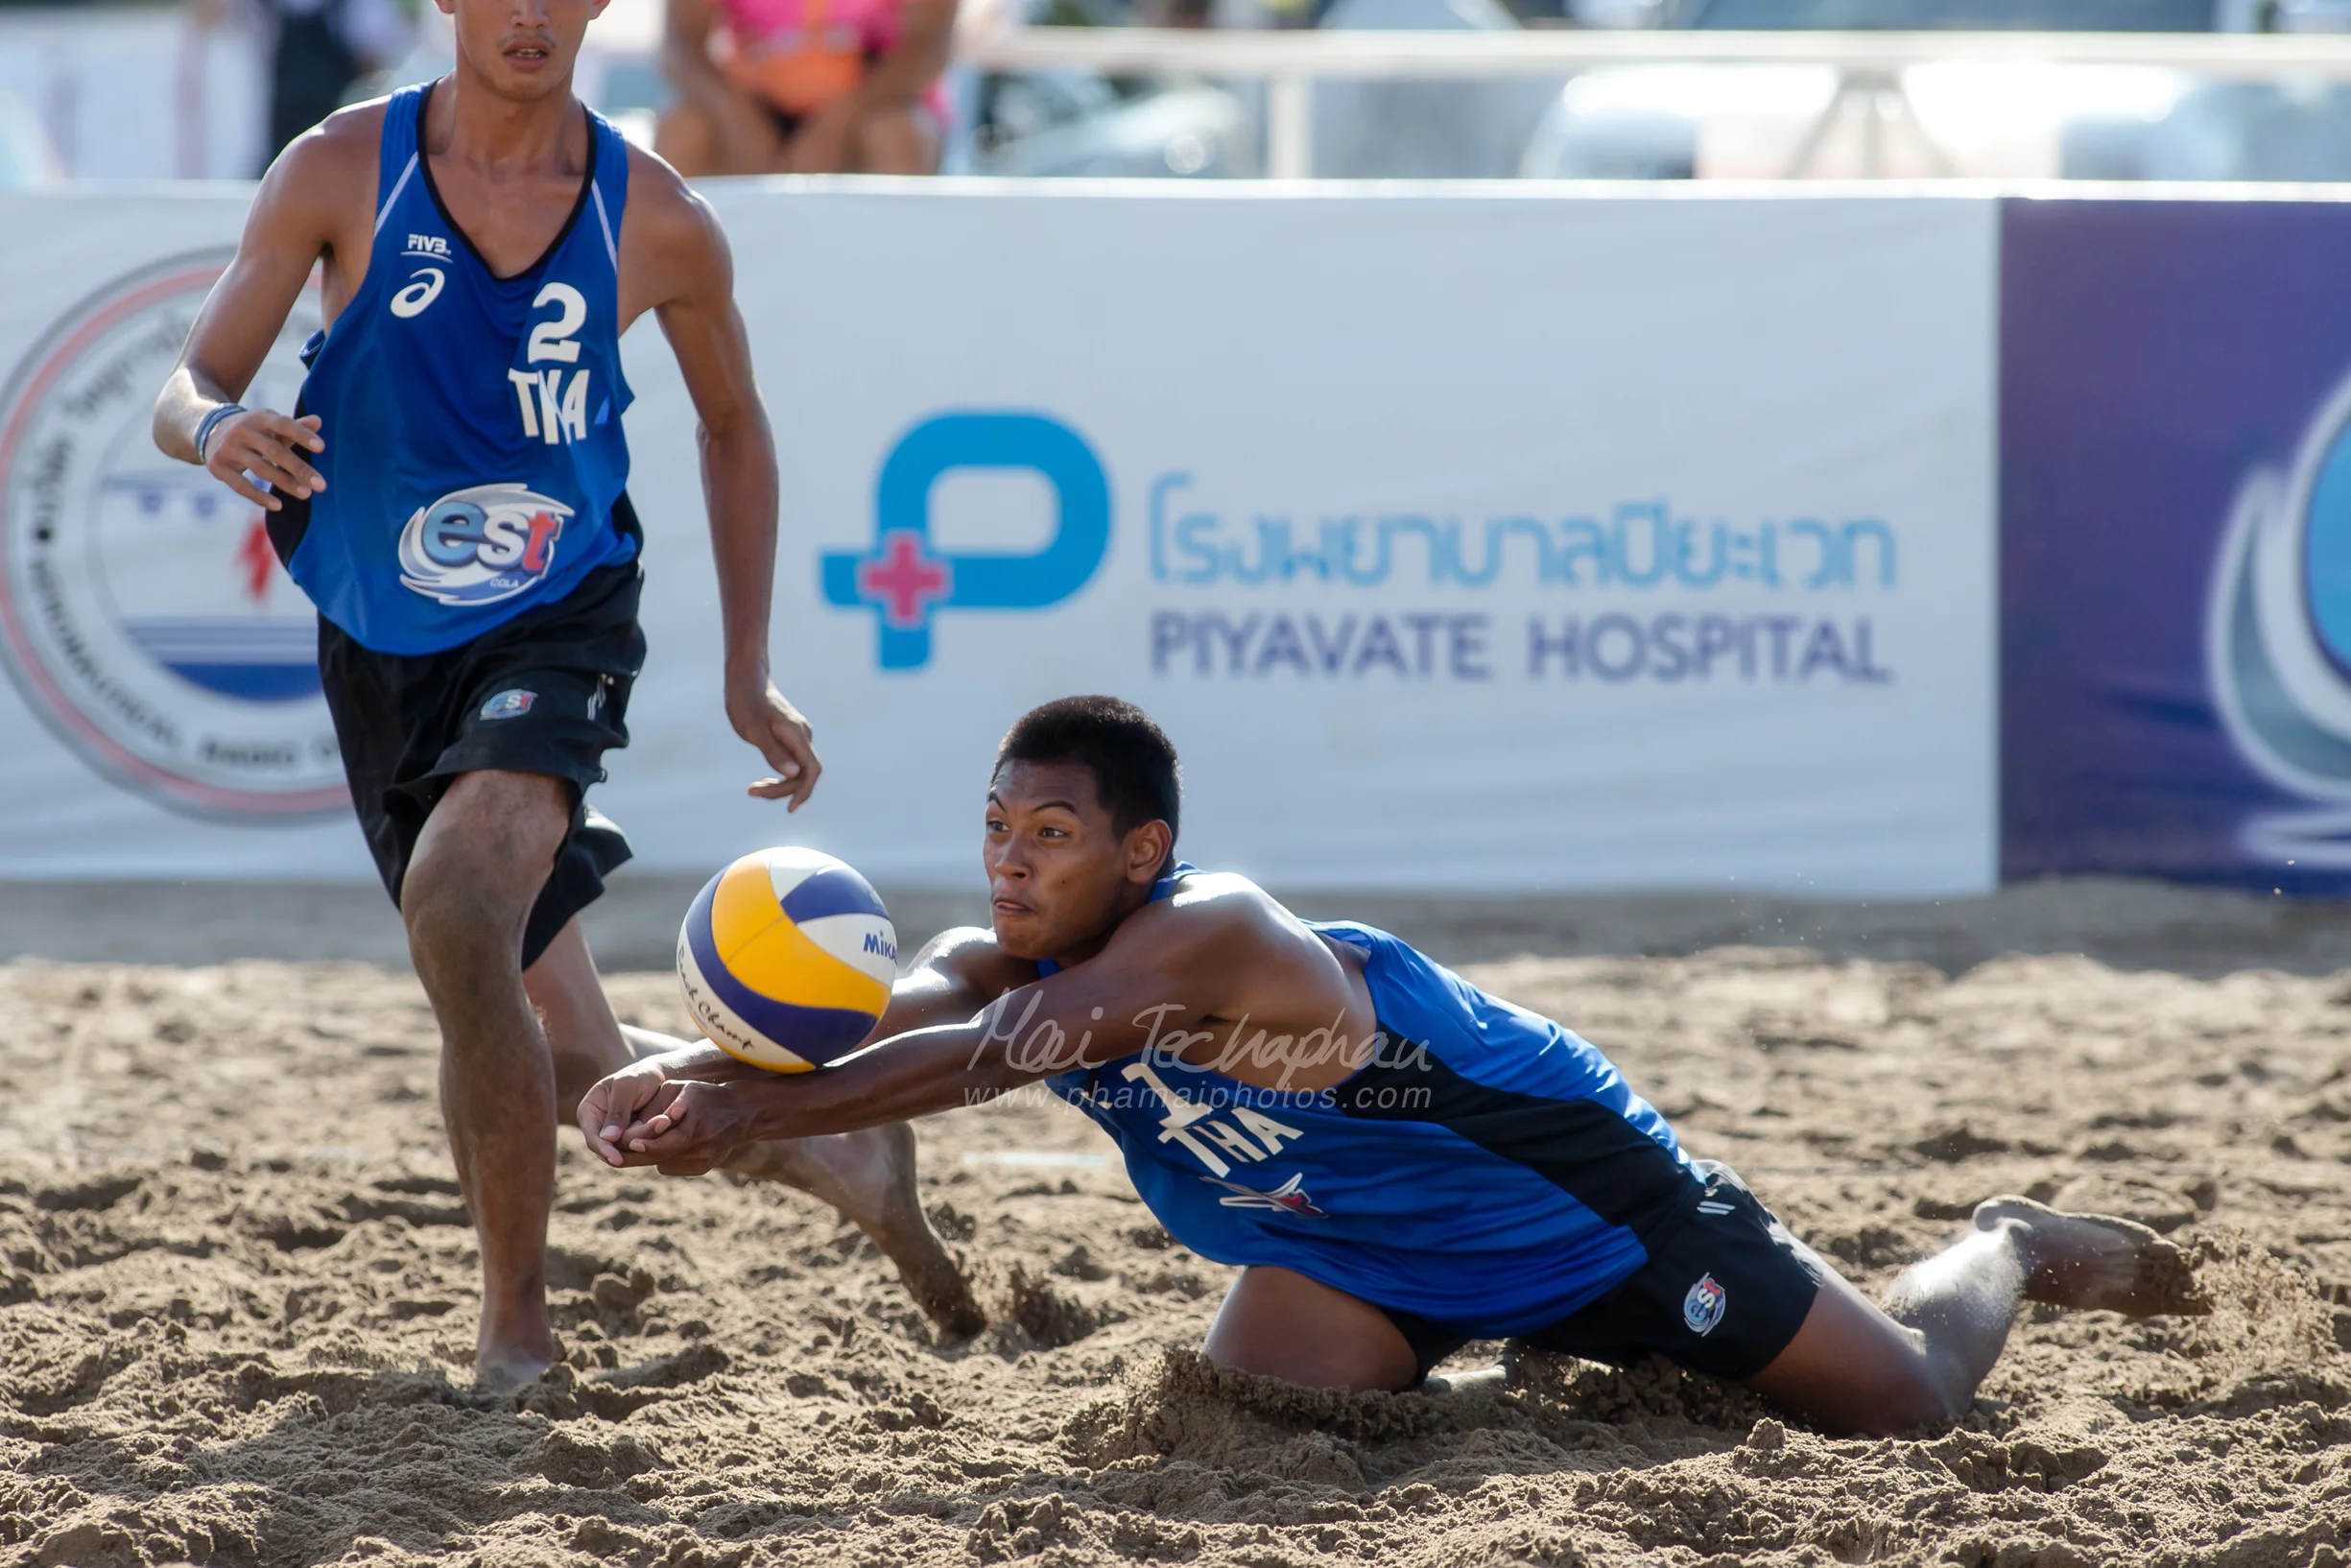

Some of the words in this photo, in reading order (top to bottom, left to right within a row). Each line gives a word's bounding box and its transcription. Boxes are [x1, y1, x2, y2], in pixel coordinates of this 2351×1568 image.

[407, 233, 448, 254] FIVB
[528, 281, 587, 365] 2
[421, 500, 558, 574] est
[489, 576, 519, 589] COLA
[1151, 610, 1494, 680] PIYAVATE
[1527, 611, 1895, 684] HOSPITAL
[1121, 1062, 1213, 1128] 1
[1157, 1106, 1304, 1179] THA
[1686, 1278, 1722, 1323] est
